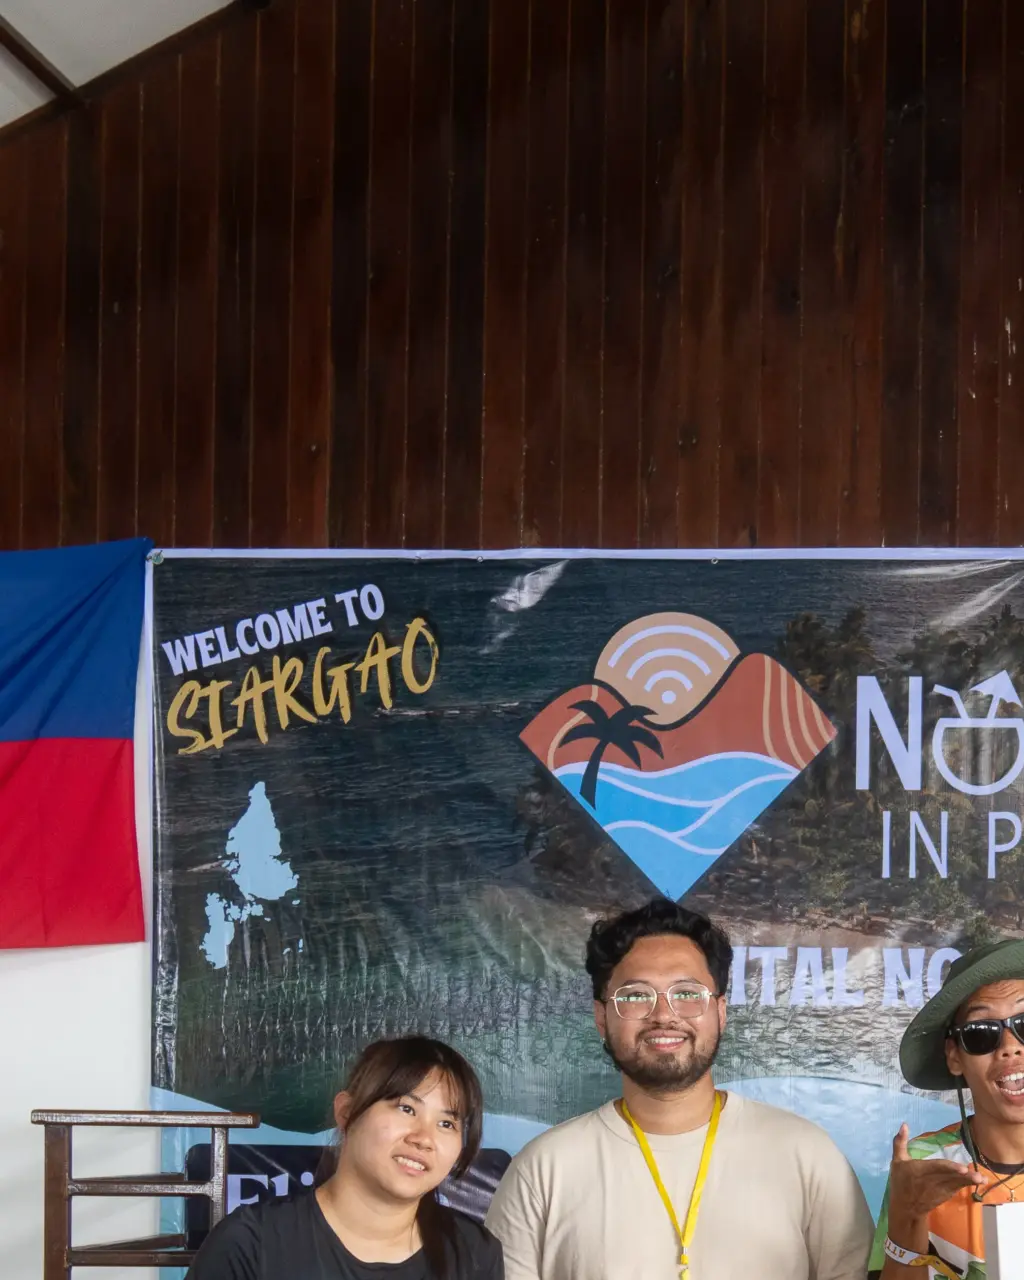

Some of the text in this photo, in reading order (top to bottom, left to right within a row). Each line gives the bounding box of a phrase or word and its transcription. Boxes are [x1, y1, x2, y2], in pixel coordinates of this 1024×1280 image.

[162, 583, 386, 677] WELCOME TO
[166, 617, 440, 755] SIARGAO
[881, 810, 949, 879] IN
[730, 946, 865, 1006] ITAL
